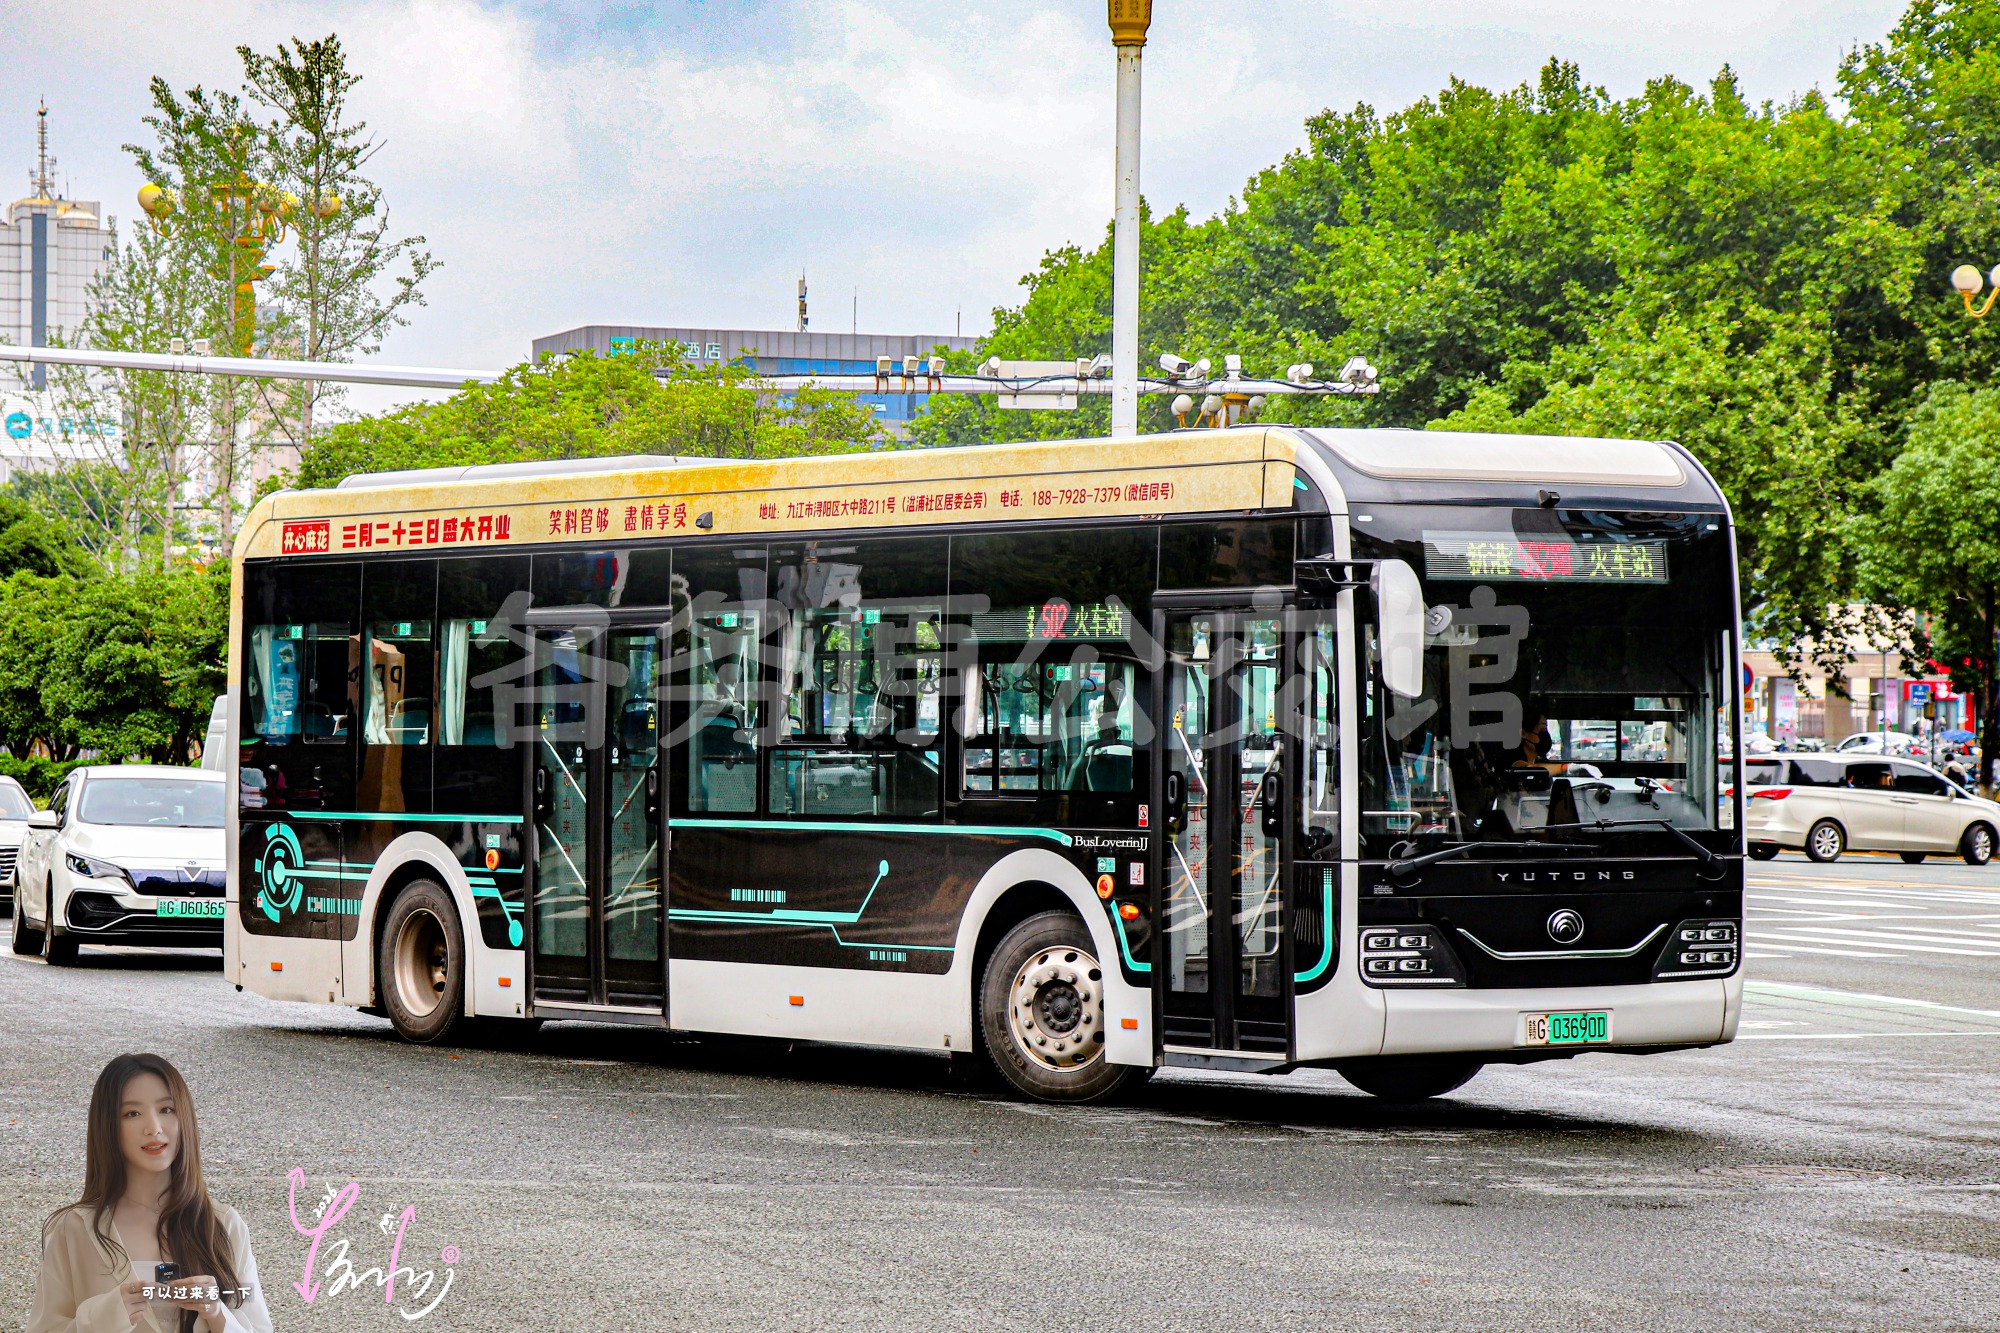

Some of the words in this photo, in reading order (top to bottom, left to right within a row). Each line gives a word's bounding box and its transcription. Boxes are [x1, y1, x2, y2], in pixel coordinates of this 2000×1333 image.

[342, 513, 511, 549] 三月二十三日盛大开业
[548, 506, 610, 536] 笑料管够
[283, 529, 329, 552] 开心麻花
[1589, 543, 1654, 578] 火车站
[1073, 603, 1123, 638] 火车站
[1497, 871, 1635, 882] YUTONG
